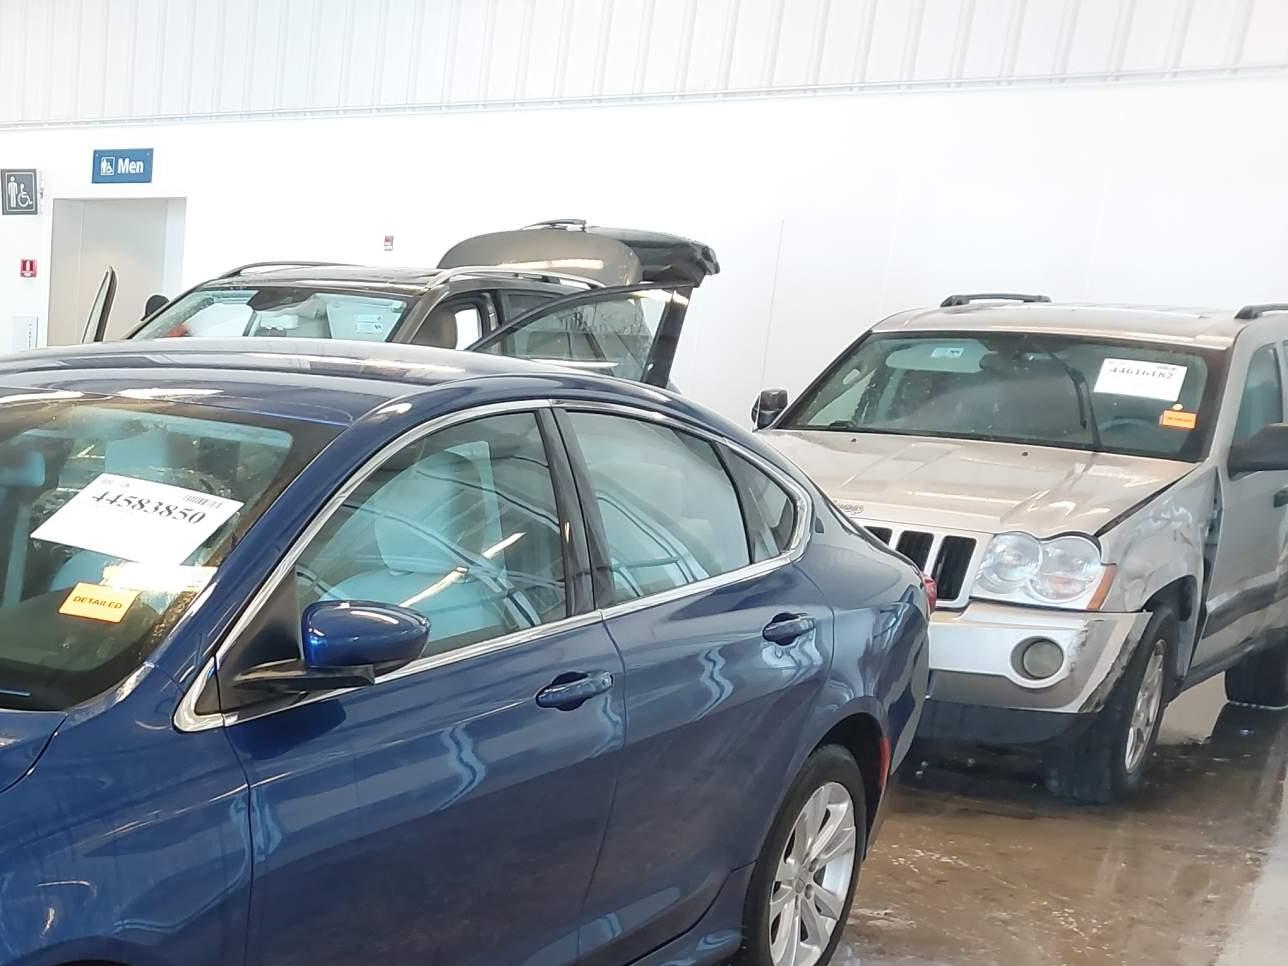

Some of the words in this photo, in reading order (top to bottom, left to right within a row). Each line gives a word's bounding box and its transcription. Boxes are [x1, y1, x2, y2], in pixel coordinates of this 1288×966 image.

[117, 158, 144, 174] Men
[92, 490, 206, 525] 44583850
[72, 595, 123, 609] DETAILED
